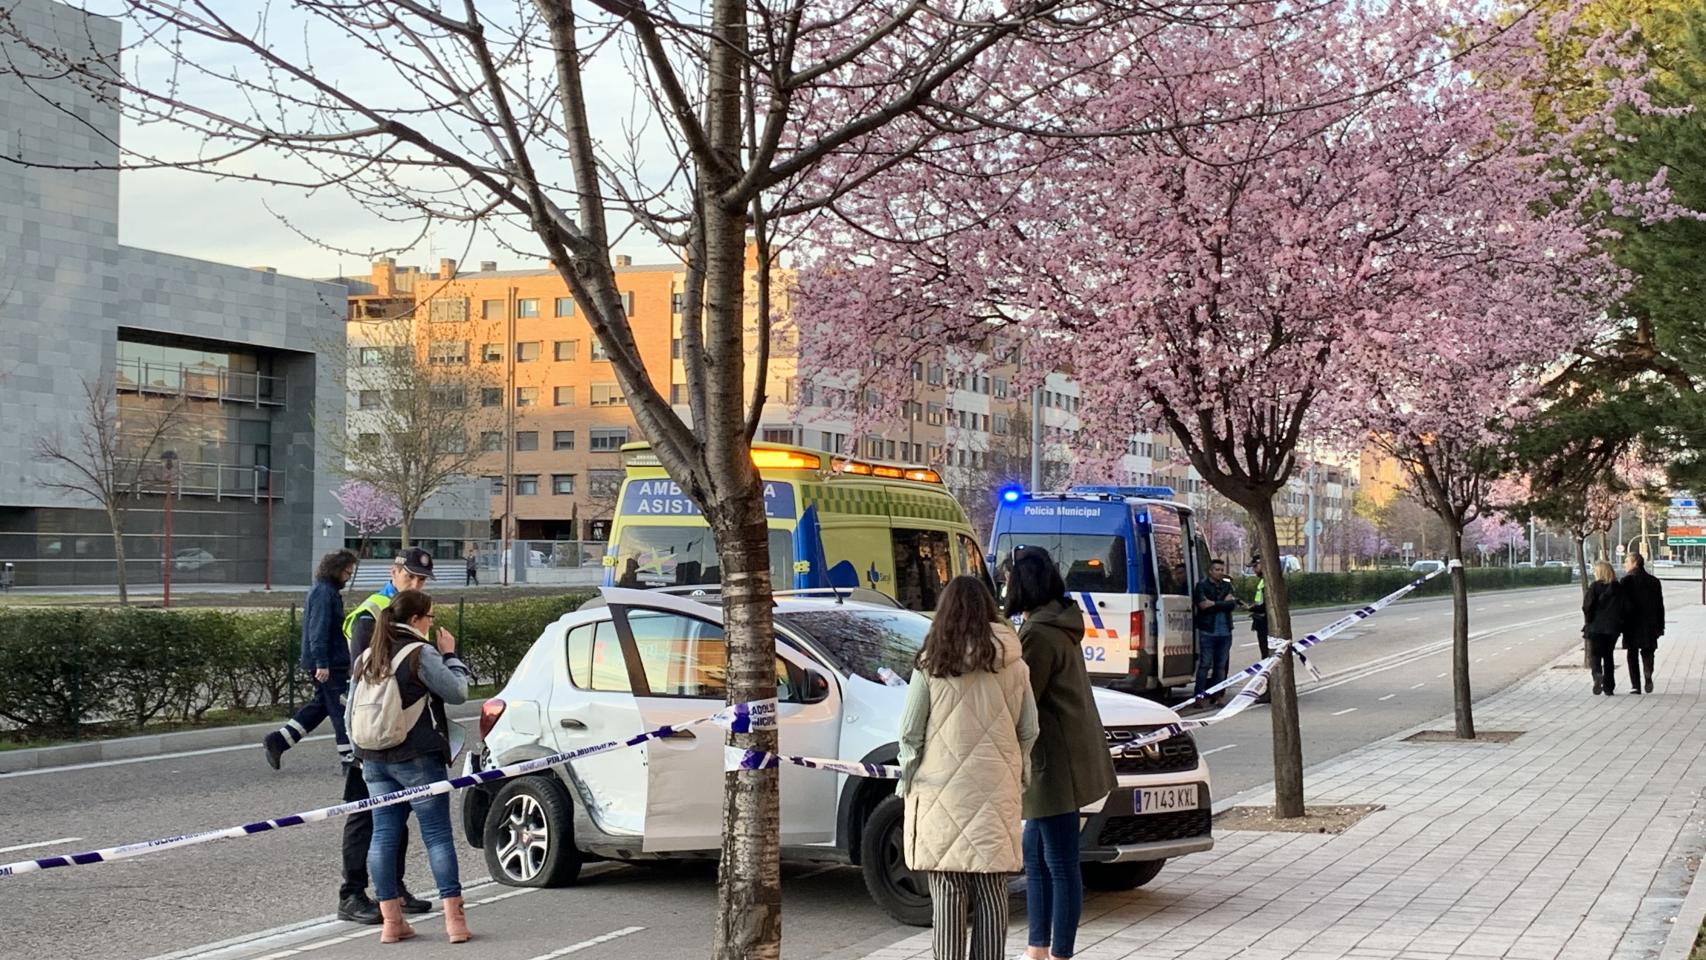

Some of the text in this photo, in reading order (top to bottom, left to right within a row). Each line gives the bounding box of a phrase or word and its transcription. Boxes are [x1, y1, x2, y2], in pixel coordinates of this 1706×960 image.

[1056, 505, 1101, 518] Municipal
[1143, 788, 1197, 811] 7143 KXL
